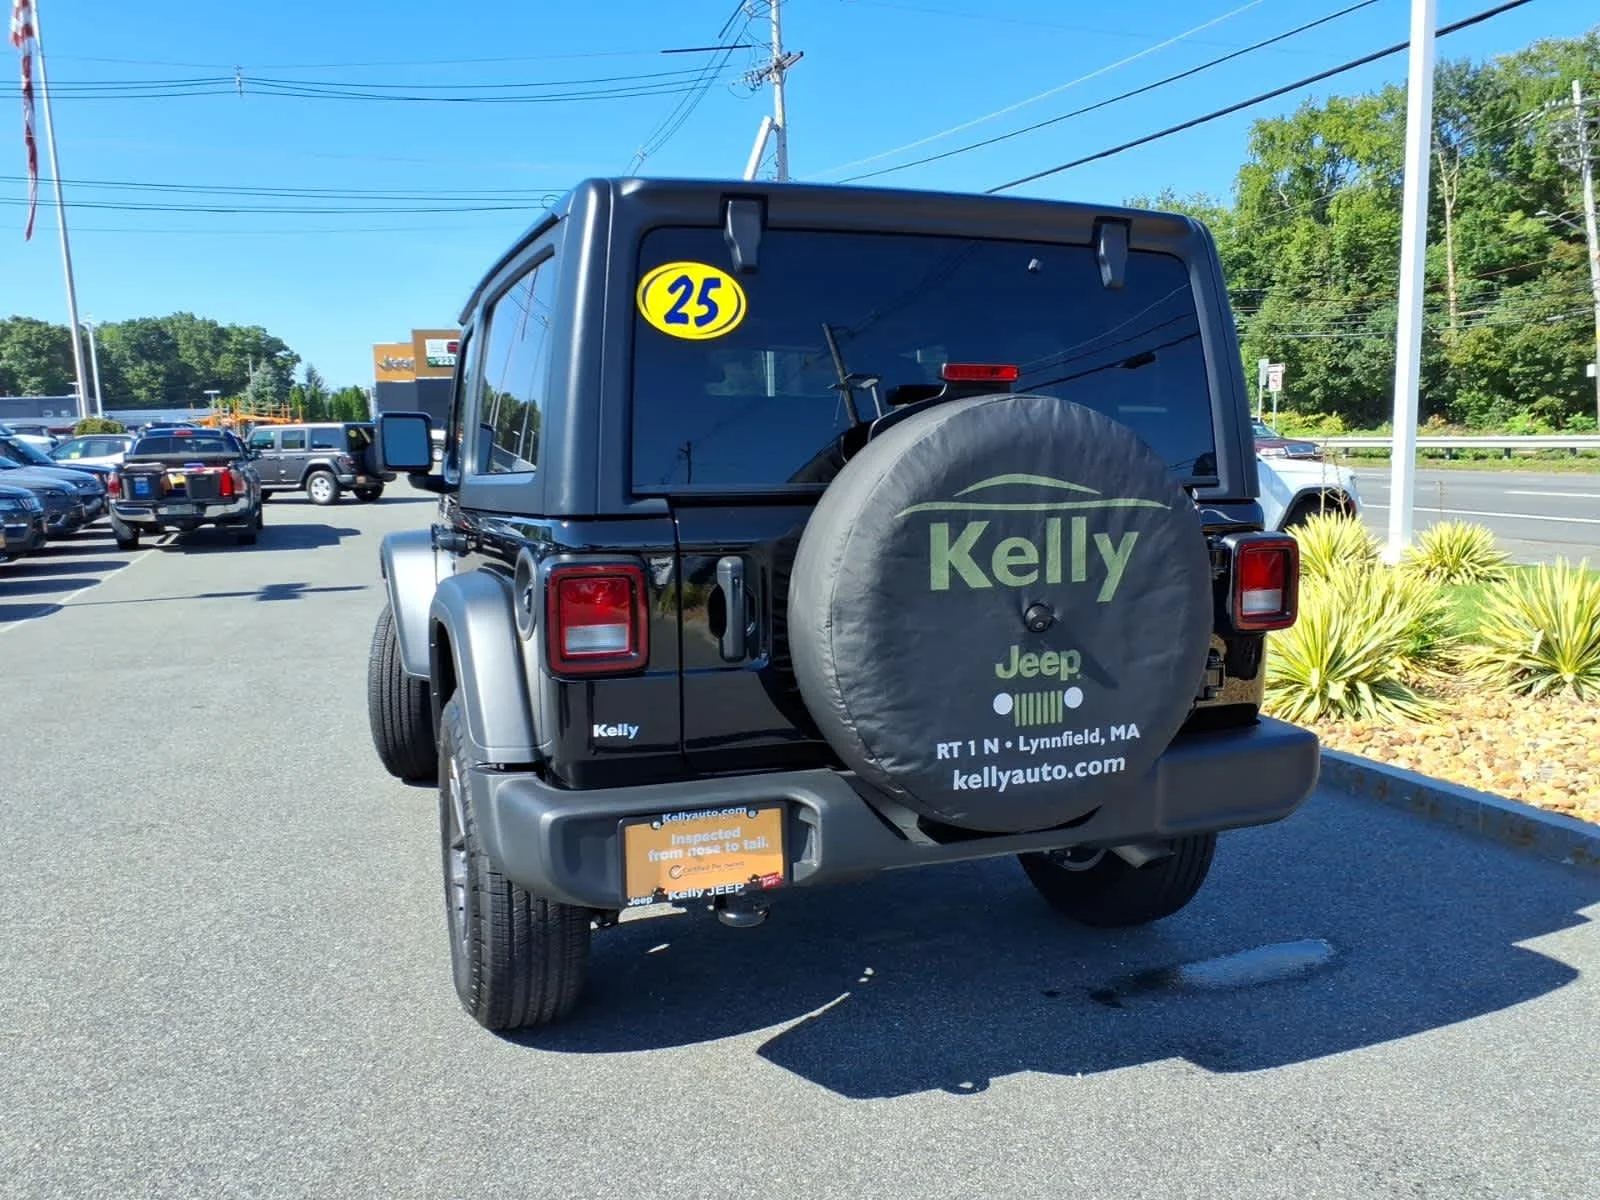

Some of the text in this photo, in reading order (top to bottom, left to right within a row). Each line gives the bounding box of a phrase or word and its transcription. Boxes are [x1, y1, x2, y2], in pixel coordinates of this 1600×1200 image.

[663, 274, 722, 327] 25
[929, 516, 1140, 603] Kelly
[995, 645, 1082, 681] Jeep
[593, 723, 639, 740] Kelly
[936, 723, 1141, 760] RT 1 N Lynnfield, MA
[952, 757, 1126, 793] kellyauto.com
[662, 807, 747, 823] Kellyauto.com
[671, 826, 742, 846] Inspected
[648, 848, 684, 863] from
[687, 844, 721, 858] nose
[725, 841, 739, 853] to
[628, 896, 653, 906] Jeep
[668, 882, 745, 901] Kelly JEEP
